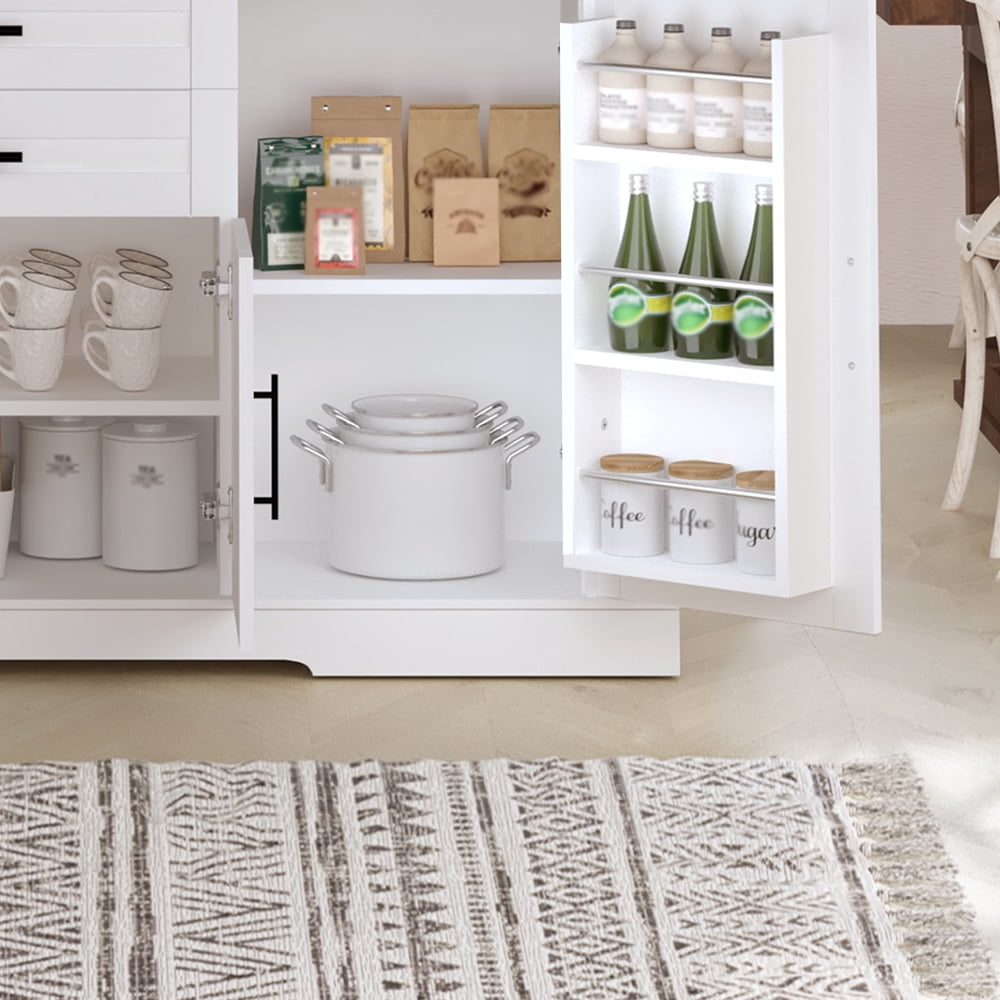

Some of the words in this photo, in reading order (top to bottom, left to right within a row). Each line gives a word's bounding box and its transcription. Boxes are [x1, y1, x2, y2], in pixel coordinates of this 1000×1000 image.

[53, 454, 72, 463] TEA
[138, 465, 156, 474] TEA
[601, 499, 645, 529] offee
[671, 506, 714, 536] offee
